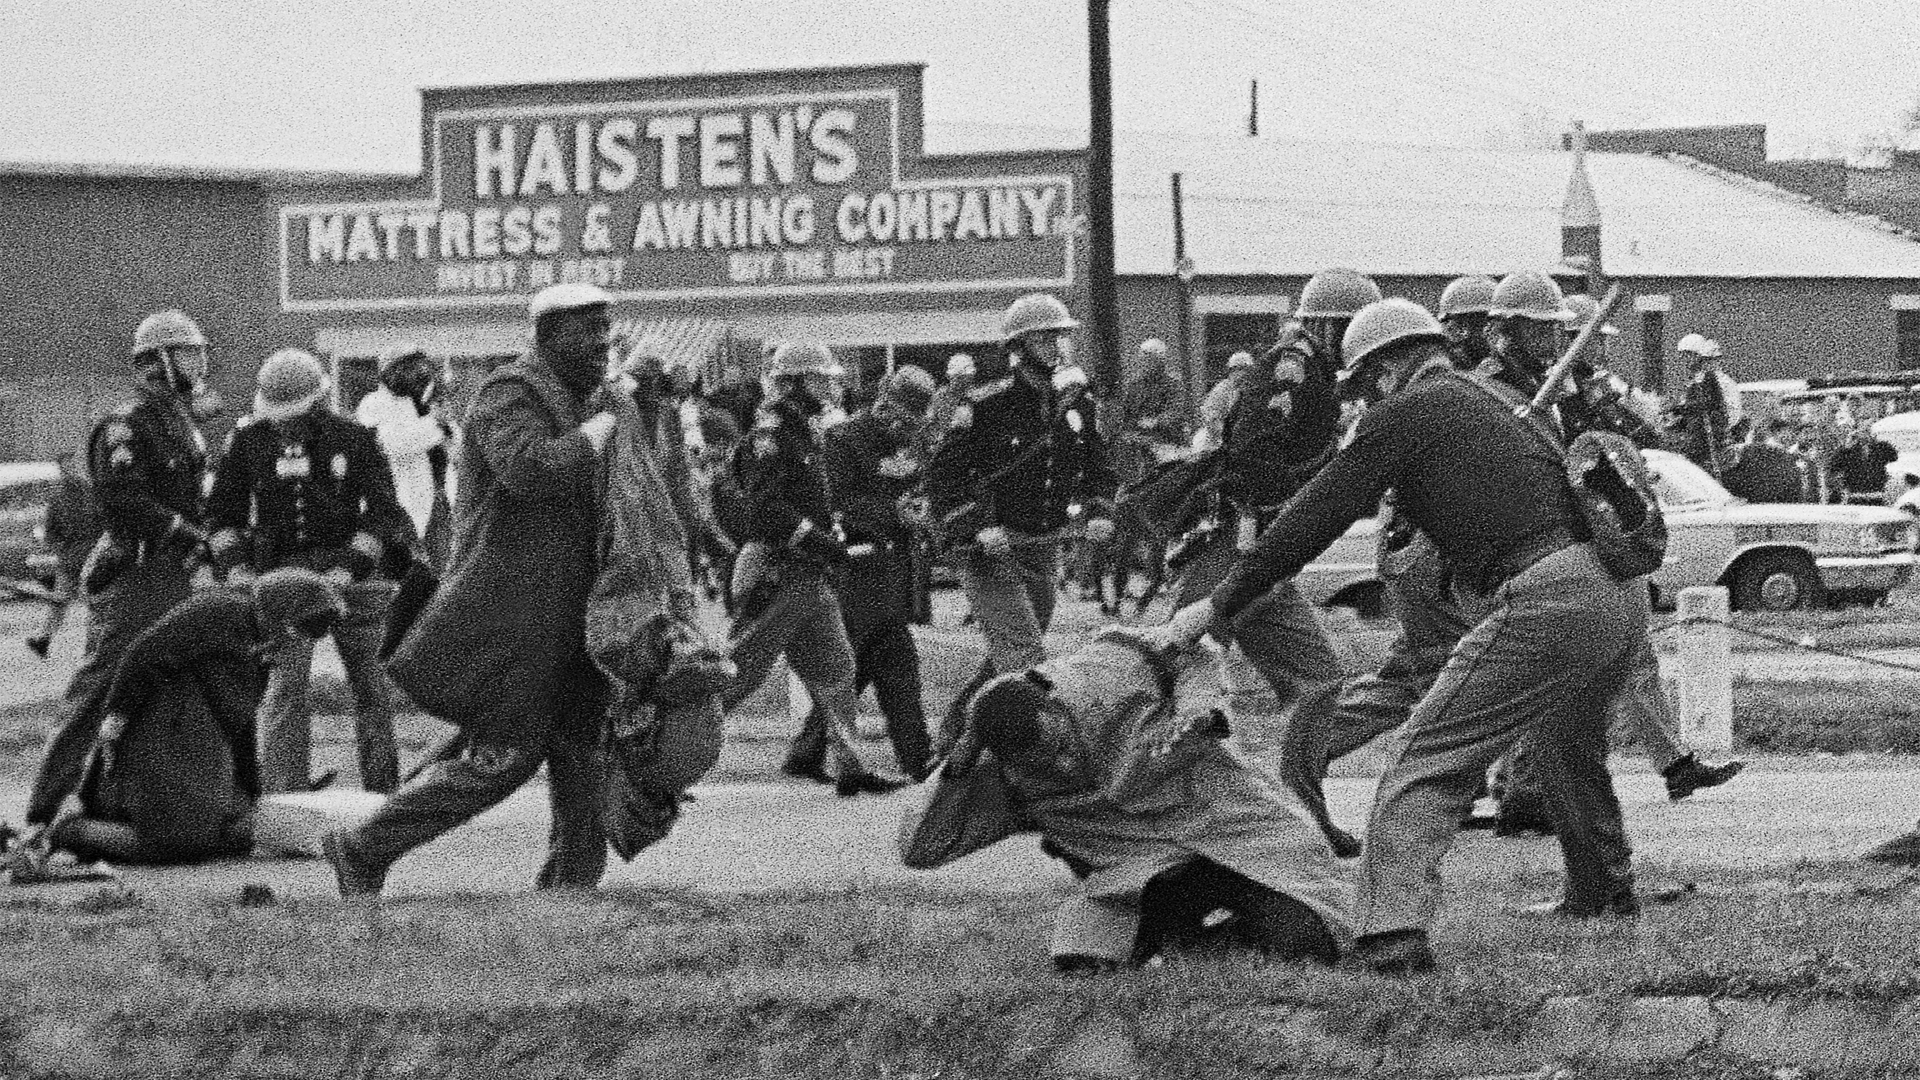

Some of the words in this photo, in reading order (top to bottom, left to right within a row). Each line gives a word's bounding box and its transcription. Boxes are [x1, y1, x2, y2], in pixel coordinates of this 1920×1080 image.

[475, 106, 859, 197] HAISTEN'S
[308, 208, 562, 263] MATTRESS
[582, 202, 613, 253] &
[632, 197, 815, 249] AWNING
[837, 189, 1057, 241] COMPANY
